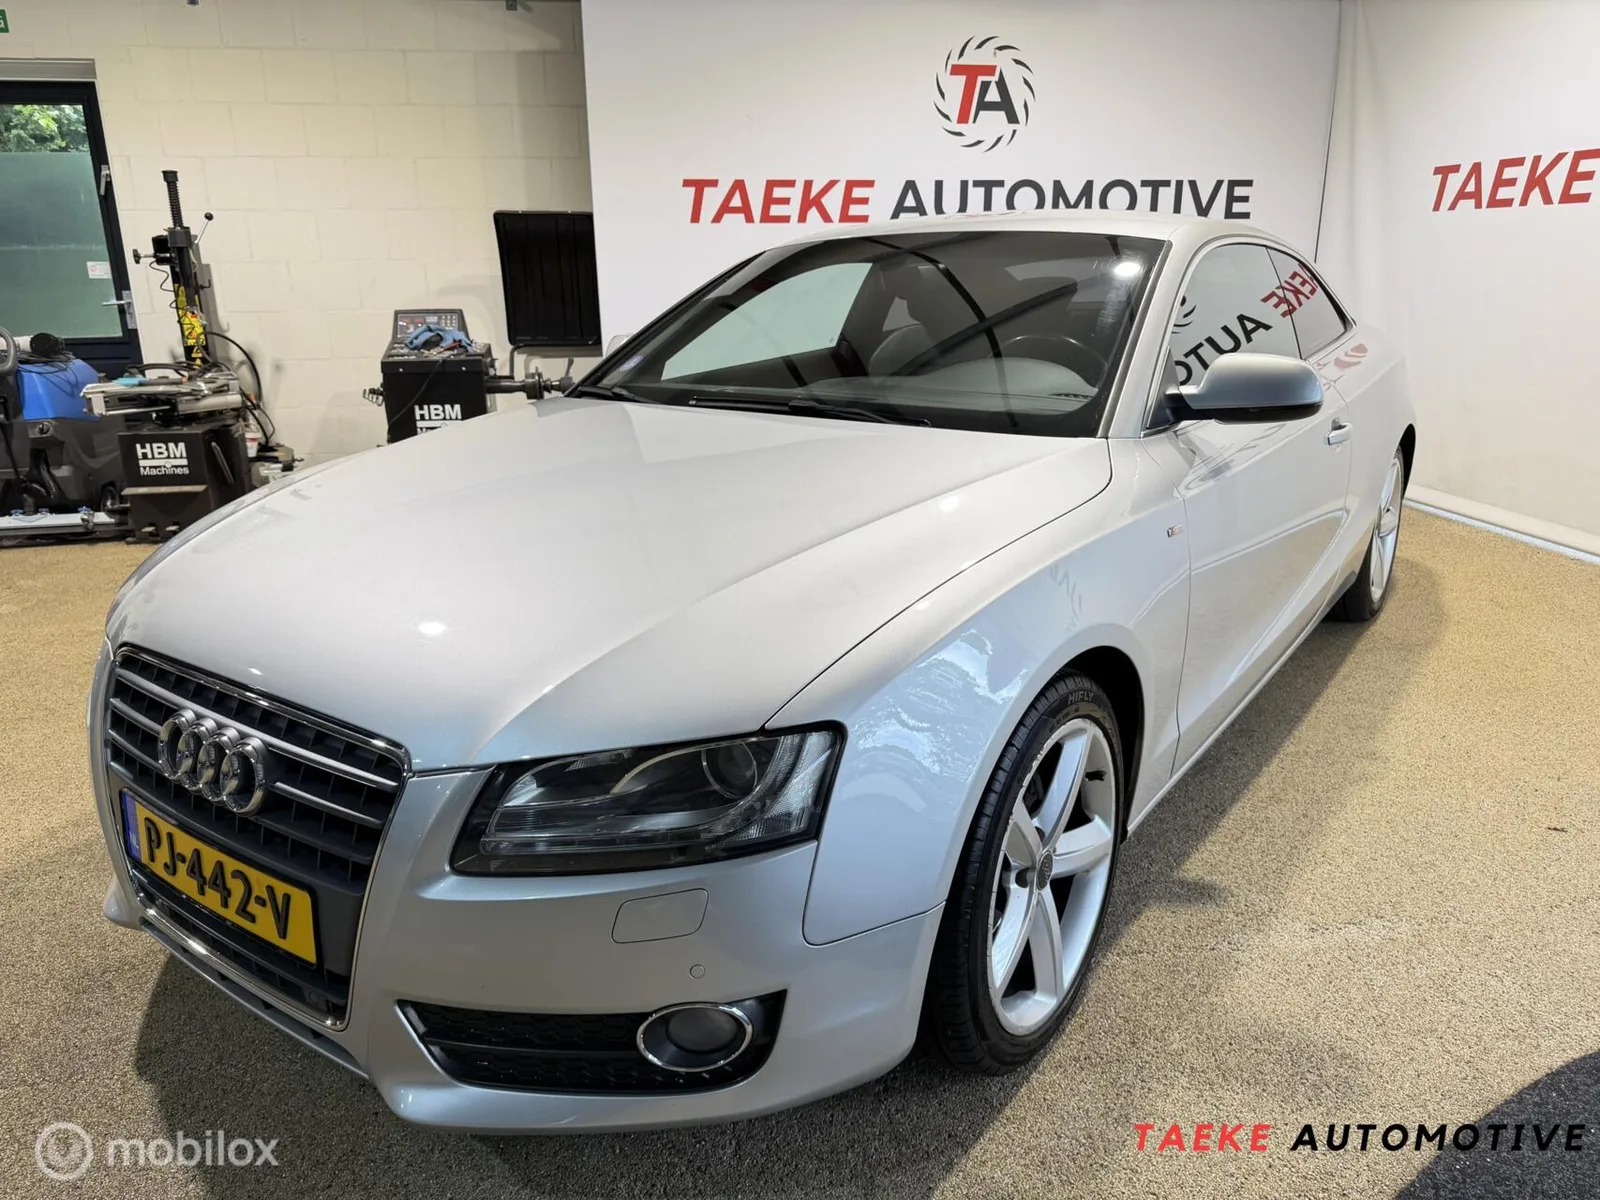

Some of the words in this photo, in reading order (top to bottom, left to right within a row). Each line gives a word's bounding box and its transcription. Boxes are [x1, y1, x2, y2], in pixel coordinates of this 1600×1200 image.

[948, 63, 1021, 125] TA
[1432, 148, 1600, 212] TAEKE
[682, 178, 875, 224] TAEKE
[890, 178, 1254, 220] AUTOMOTIVE
[414, 404, 462, 420] HBM
[135, 442, 188, 460] HBM
[140, 466, 190, 476] Machines
[1067, 690, 1094, 706] HIFLY
[143, 816, 292, 941] PJ-442-V
